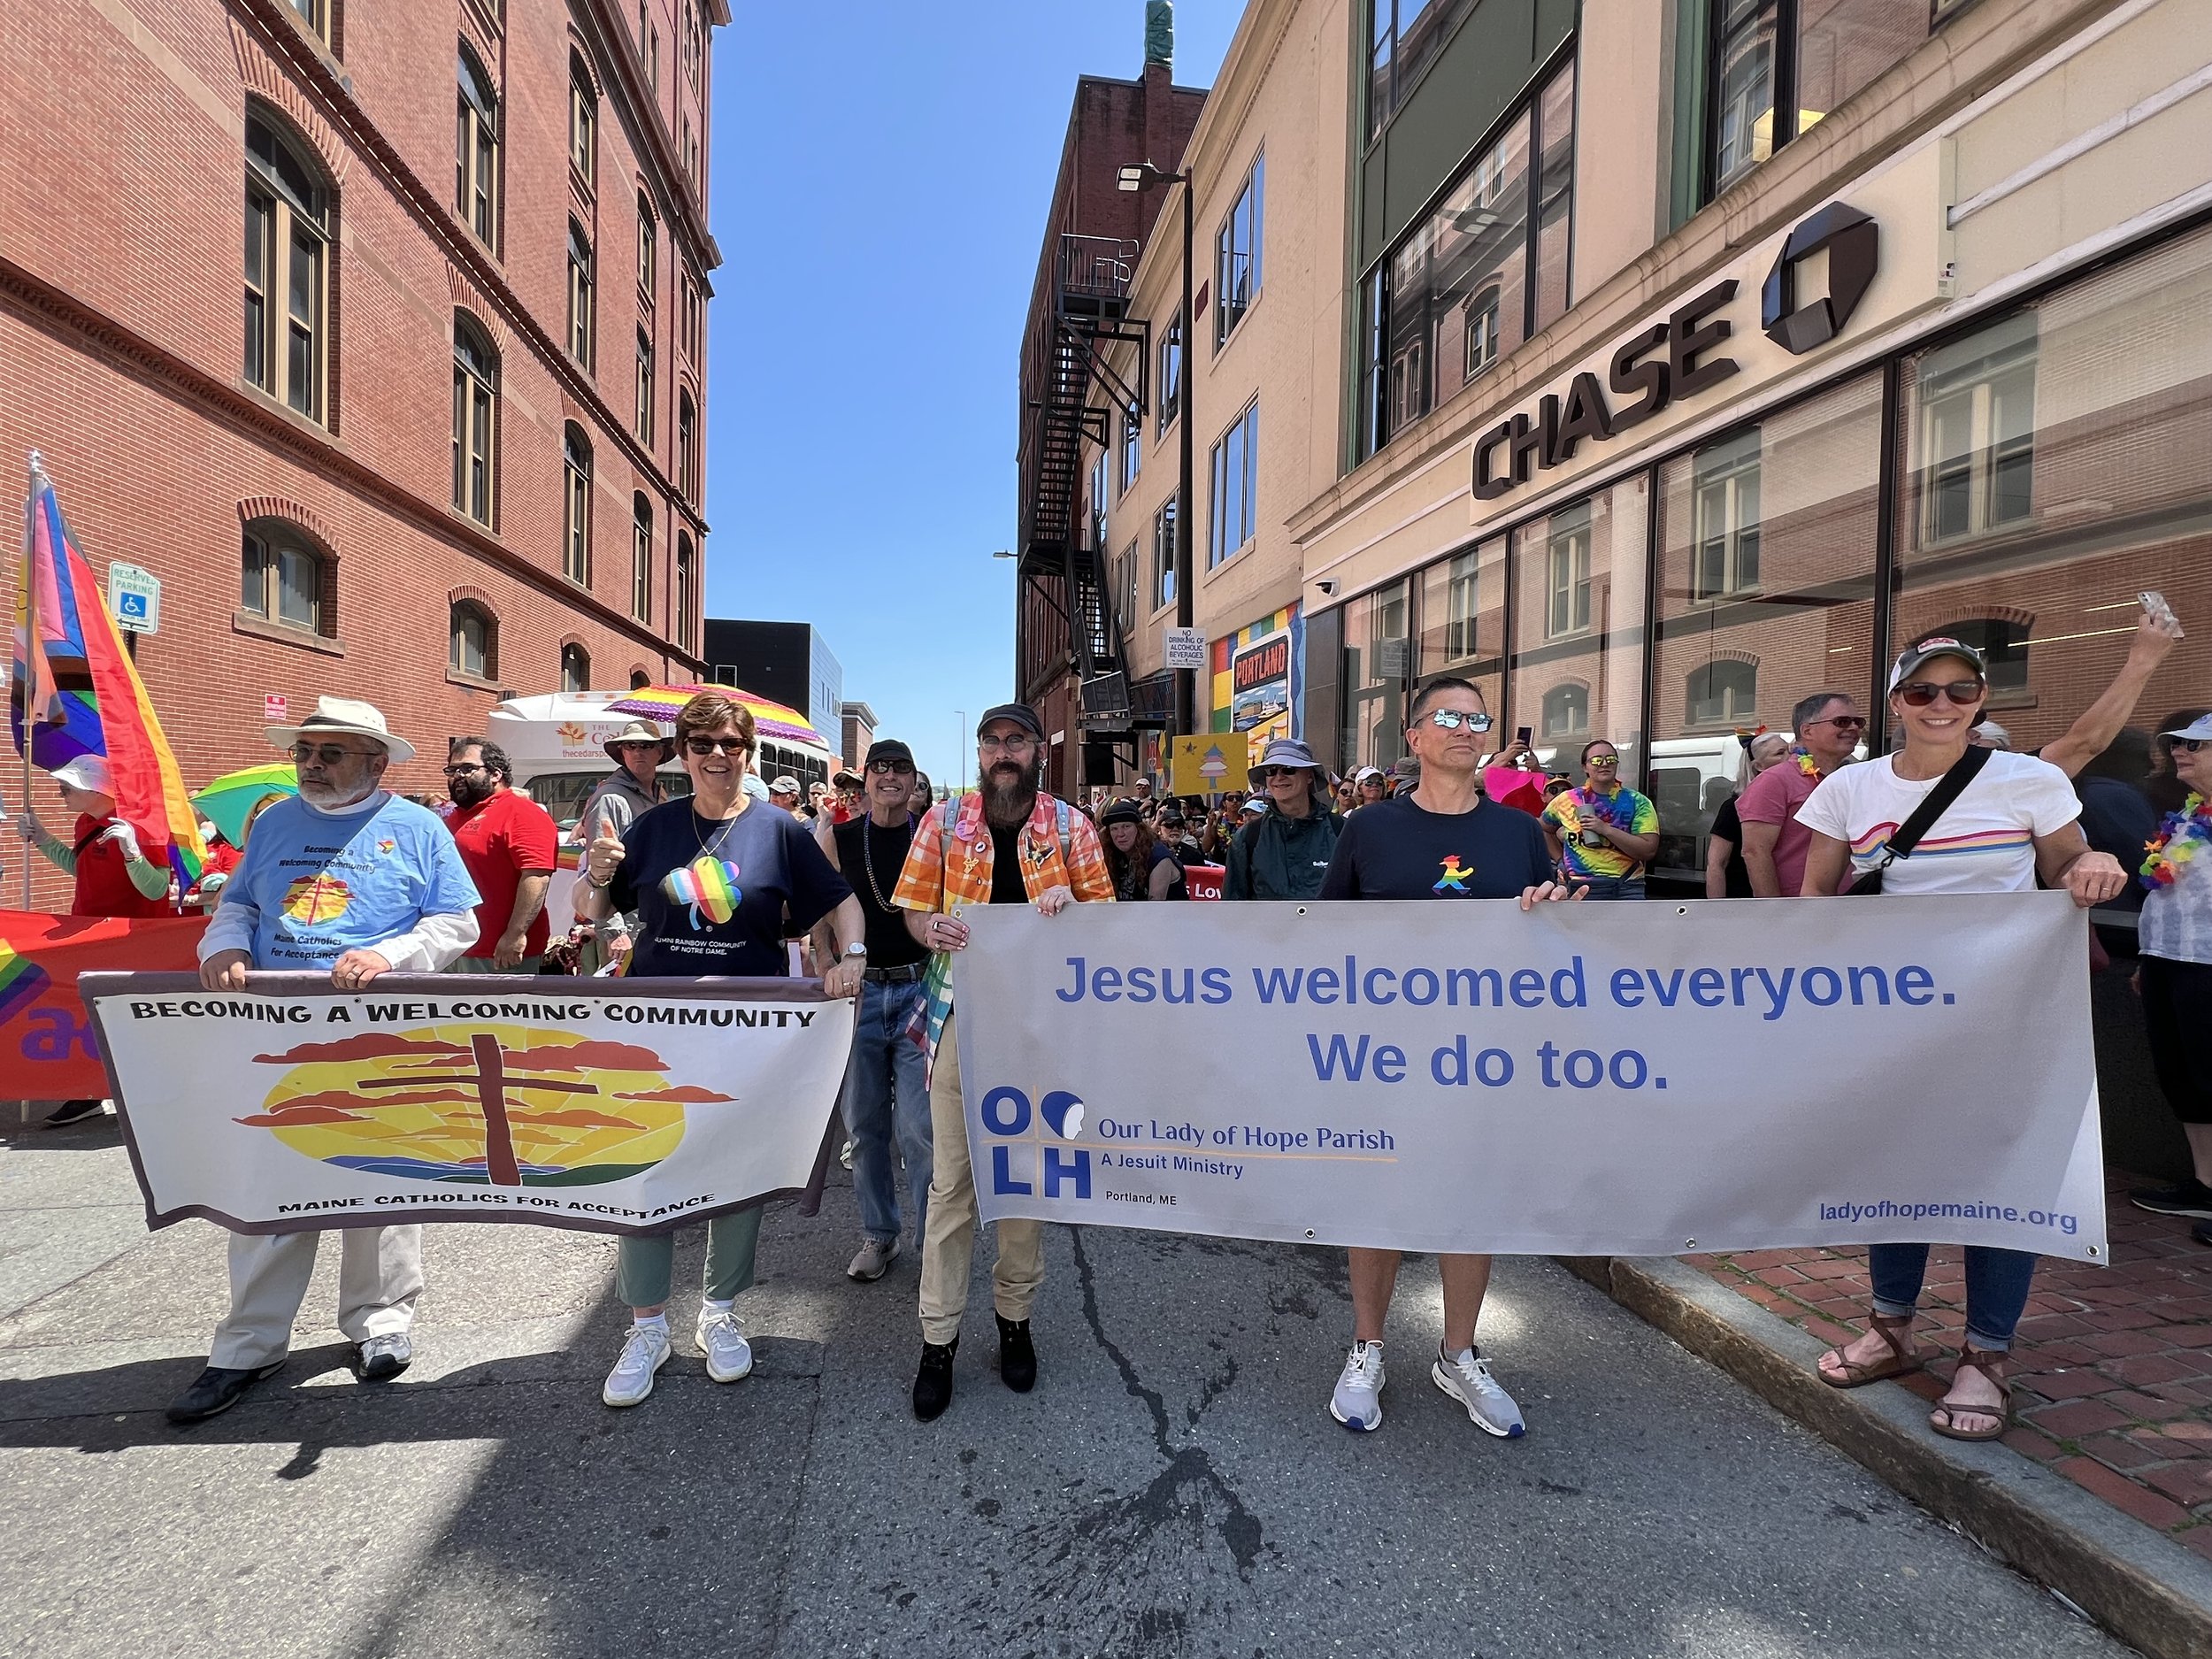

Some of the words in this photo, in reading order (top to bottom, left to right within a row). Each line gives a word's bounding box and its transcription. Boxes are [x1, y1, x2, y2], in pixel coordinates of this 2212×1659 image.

[1472, 279, 1740, 501] CHASE
[113, 569, 156, 584] RESERVED
[115, 580, 153, 595] PARKING
[1236, 643, 1286, 687] PORTLAND
[304, 845, 345, 857] Becoming
[279, 859, 322, 870] Welcoming
[325, 861, 374, 873] Community
[273, 933, 295, 944] Maine
[297, 935, 342, 946] Catholics
[271, 948, 283, 956] For
[285, 949, 340, 961] Acceptance
[1056, 956, 1233, 1005] Jesus
[1252, 955, 1588, 1008] welcomed
[1609, 963, 1956, 1021] everyone.
[130, 1002, 312, 1024] BECOMING
[326, 1005, 352, 1023] A
[365, 1002, 591, 1022] WELCOMING
[603, 1003, 818, 1028] COMMUNITY
[1306, 1033, 1408, 1084] We
[1430, 1035, 1515, 1087] do
[1536, 1040, 1668, 1089] too.
[1098, 1118, 1144, 1141] Our
[1150, 1119, 1205, 1148] Lady
[1212, 1125, 1239, 1146] of
[1244, 1126, 1309, 1152] Hope
[1316, 1127, 1395, 1151] Parish
[1101, 1155, 1113, 1167] A
[1118, 1154, 1168, 1170] Jesuit
[1173, 1156, 1244, 1179] Ministry
[278, 1197, 365, 1213] MAINE
[374, 1194, 509, 1205] CATHOLICS
[517, 1196, 560, 1208] FOR
[567, 1192, 716, 1219] ACCEPTANCE
[1105, 1191, 1156, 1205] Portland,
[1158, 1194, 1178, 1205] ME
[1820, 1199, 2078, 1233] ladyofhopemaine.org
